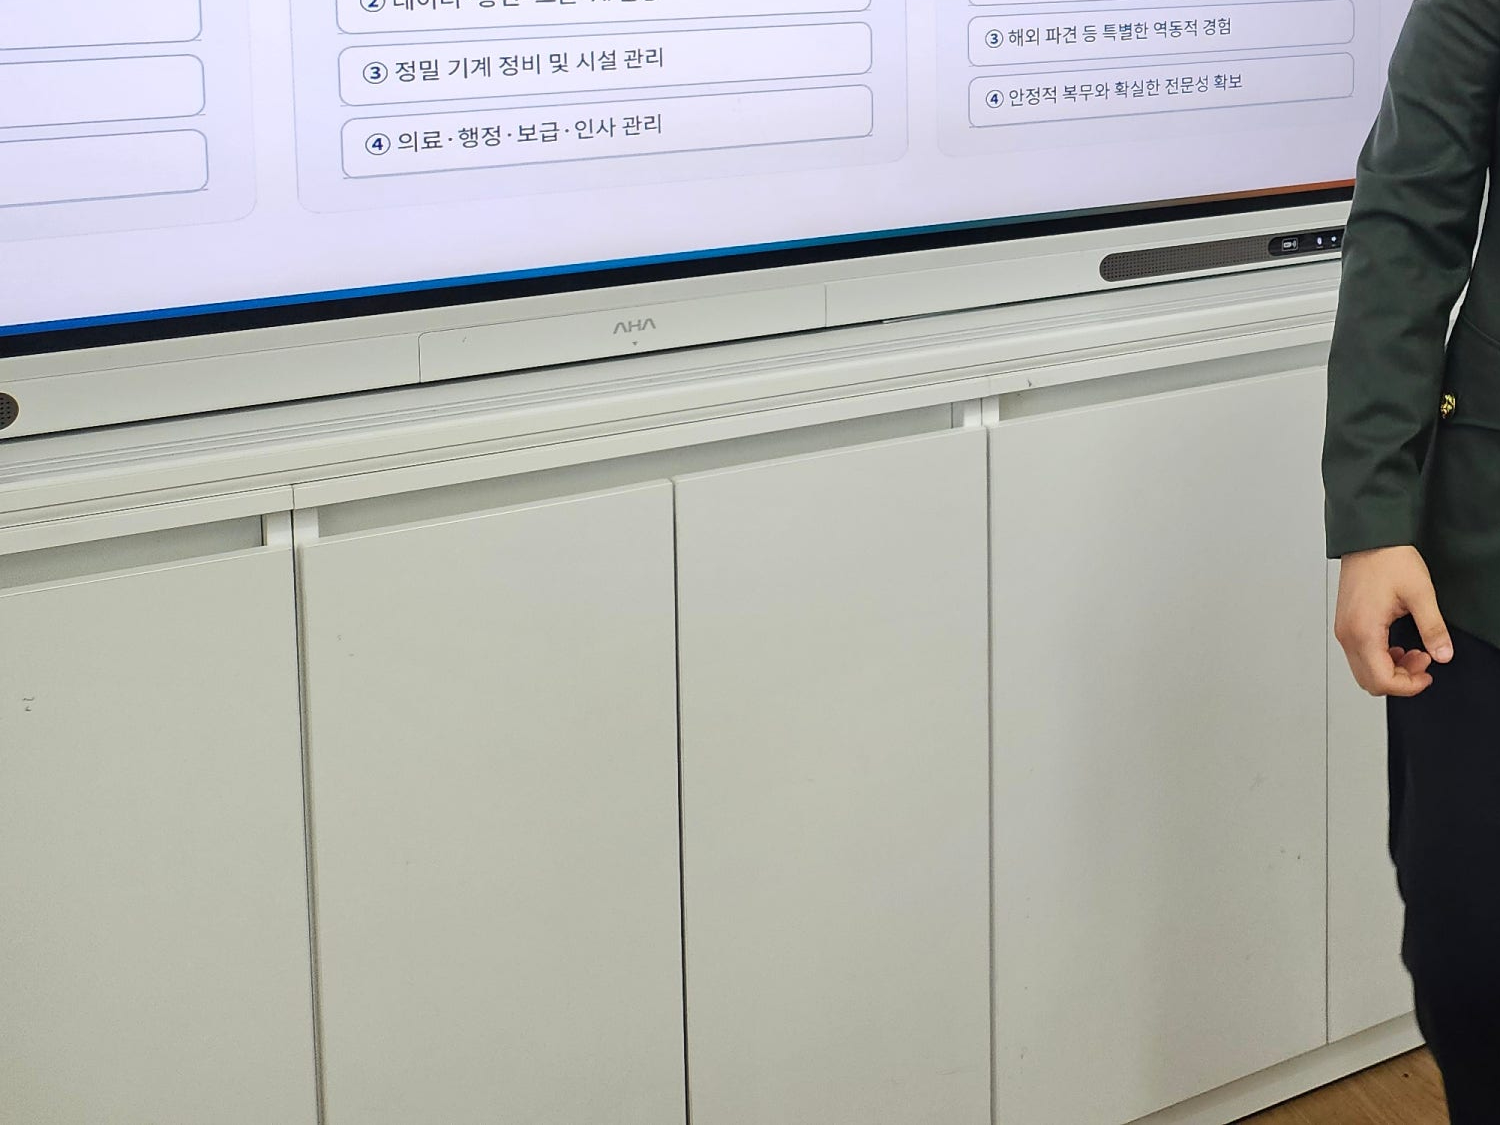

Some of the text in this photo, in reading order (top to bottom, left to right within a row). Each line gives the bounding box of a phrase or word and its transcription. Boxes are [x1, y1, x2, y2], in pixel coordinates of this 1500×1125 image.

[1007, 27, 1040, 47] 해외
[1044, 25, 1077, 45] 파견
[1081, 24, 1098, 43] 등
[1102, 21, 1150, 42] 특별한
[1153, 18, 1198, 39] 역동적
[1202, 17, 1231, 36] 경험
[394, 58, 440, 83] 정밀
[448, 56, 491, 80] 기계
[498, 53, 541, 77] 정비
[549, 51, 569, 74] 및
[576, 49, 617, 72] 시설
[623, 47, 663, 70] 관리
[1008, 85, 1057, 108] 안정적
[1062, 82, 1111, 103] 복무와
[1114, 78, 1161, 99] 확실한
[1164, 74, 1209, 96] 전문성
[1213, 73, 1243, 92] 확보
[620, 113, 663, 137] 관리
[612, 317, 657, 335] AHA
